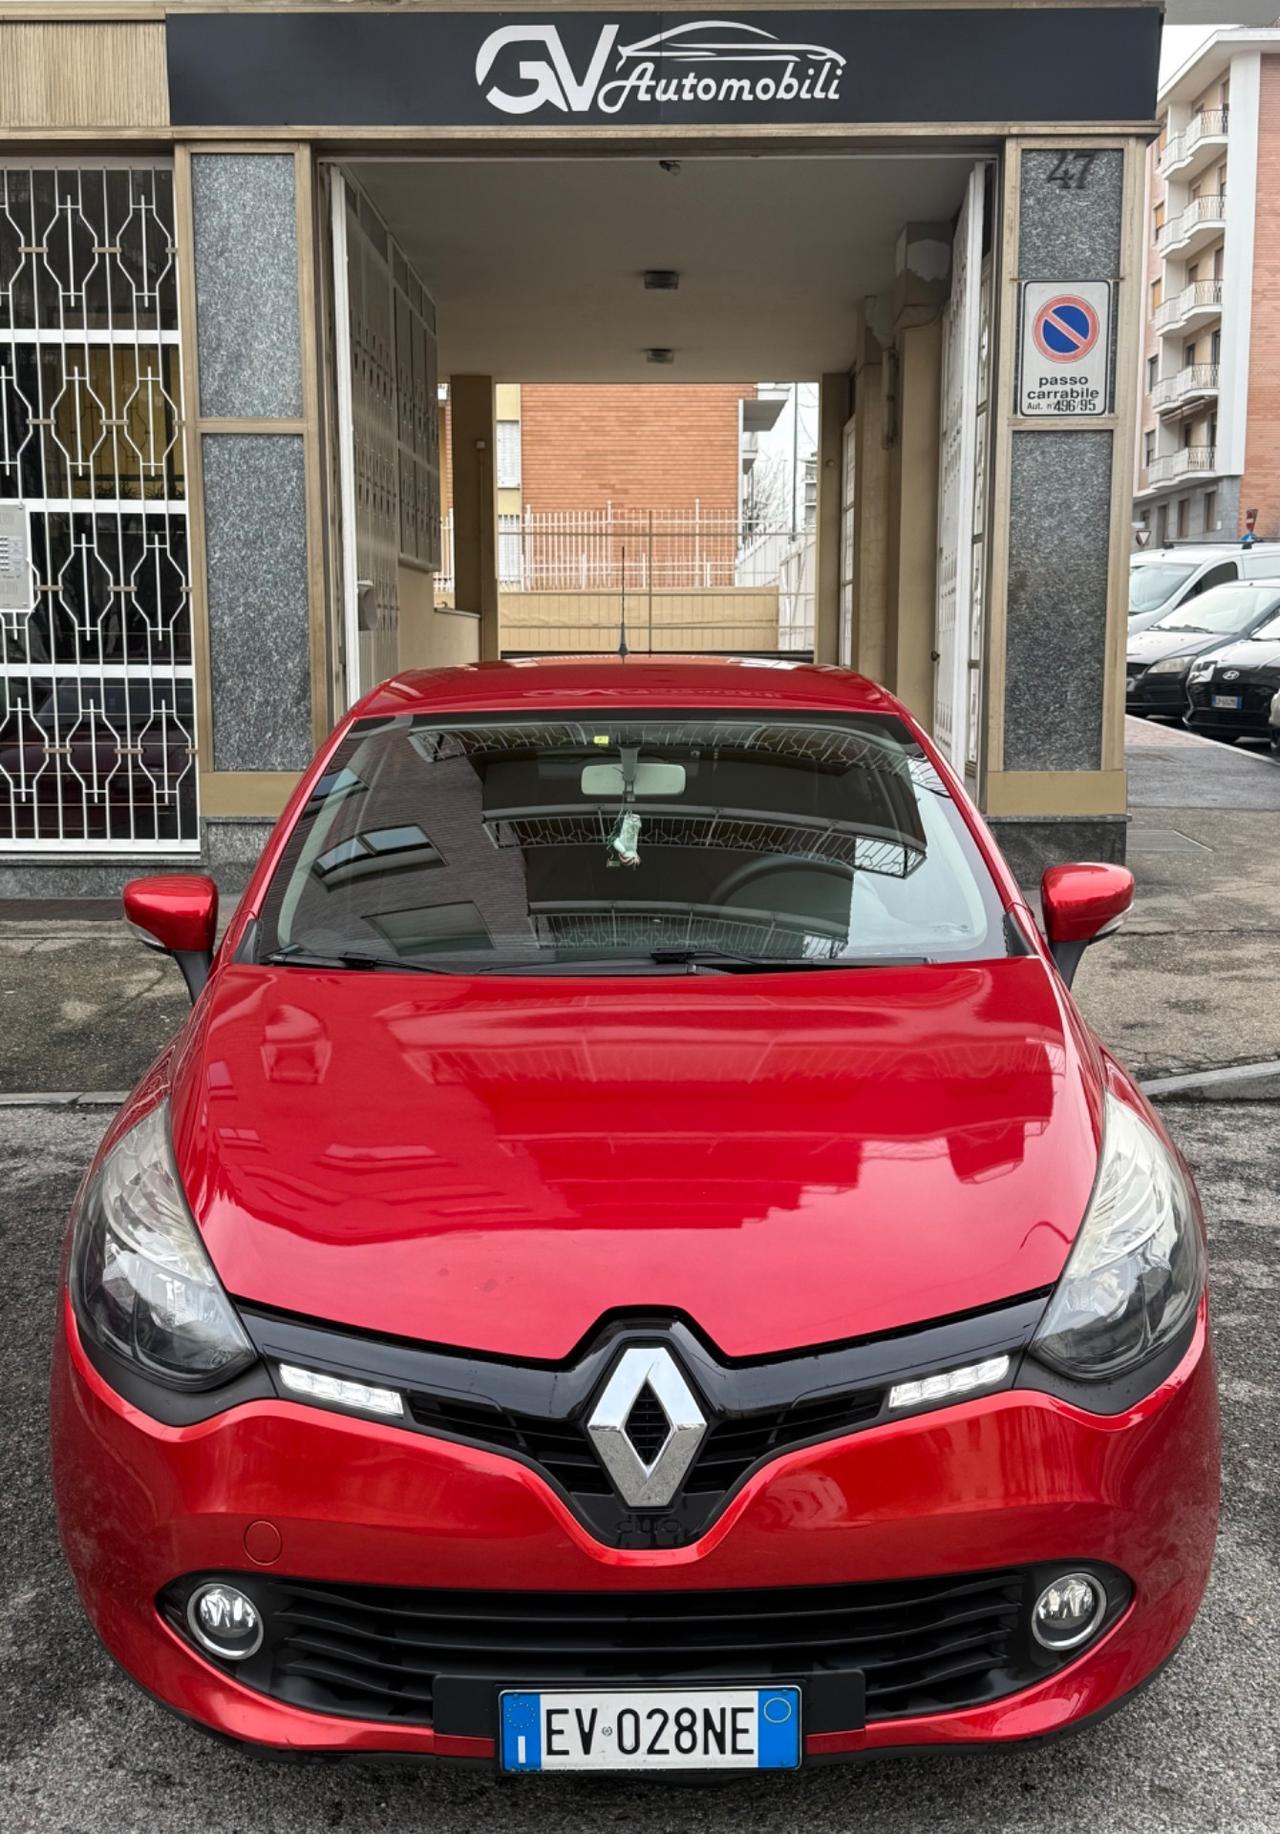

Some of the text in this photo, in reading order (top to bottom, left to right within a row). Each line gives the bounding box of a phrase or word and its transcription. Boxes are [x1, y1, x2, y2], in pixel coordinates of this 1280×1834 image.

[475, 24, 844, 114] GV Automobili
[1047, 151, 1097, 189] 47
[1027, 387, 1099, 399] carrabile
[1039, 376, 1089, 388] passo
[1027, 402, 1043, 410] Aut.
[546, 1708, 598, 1755] EV
